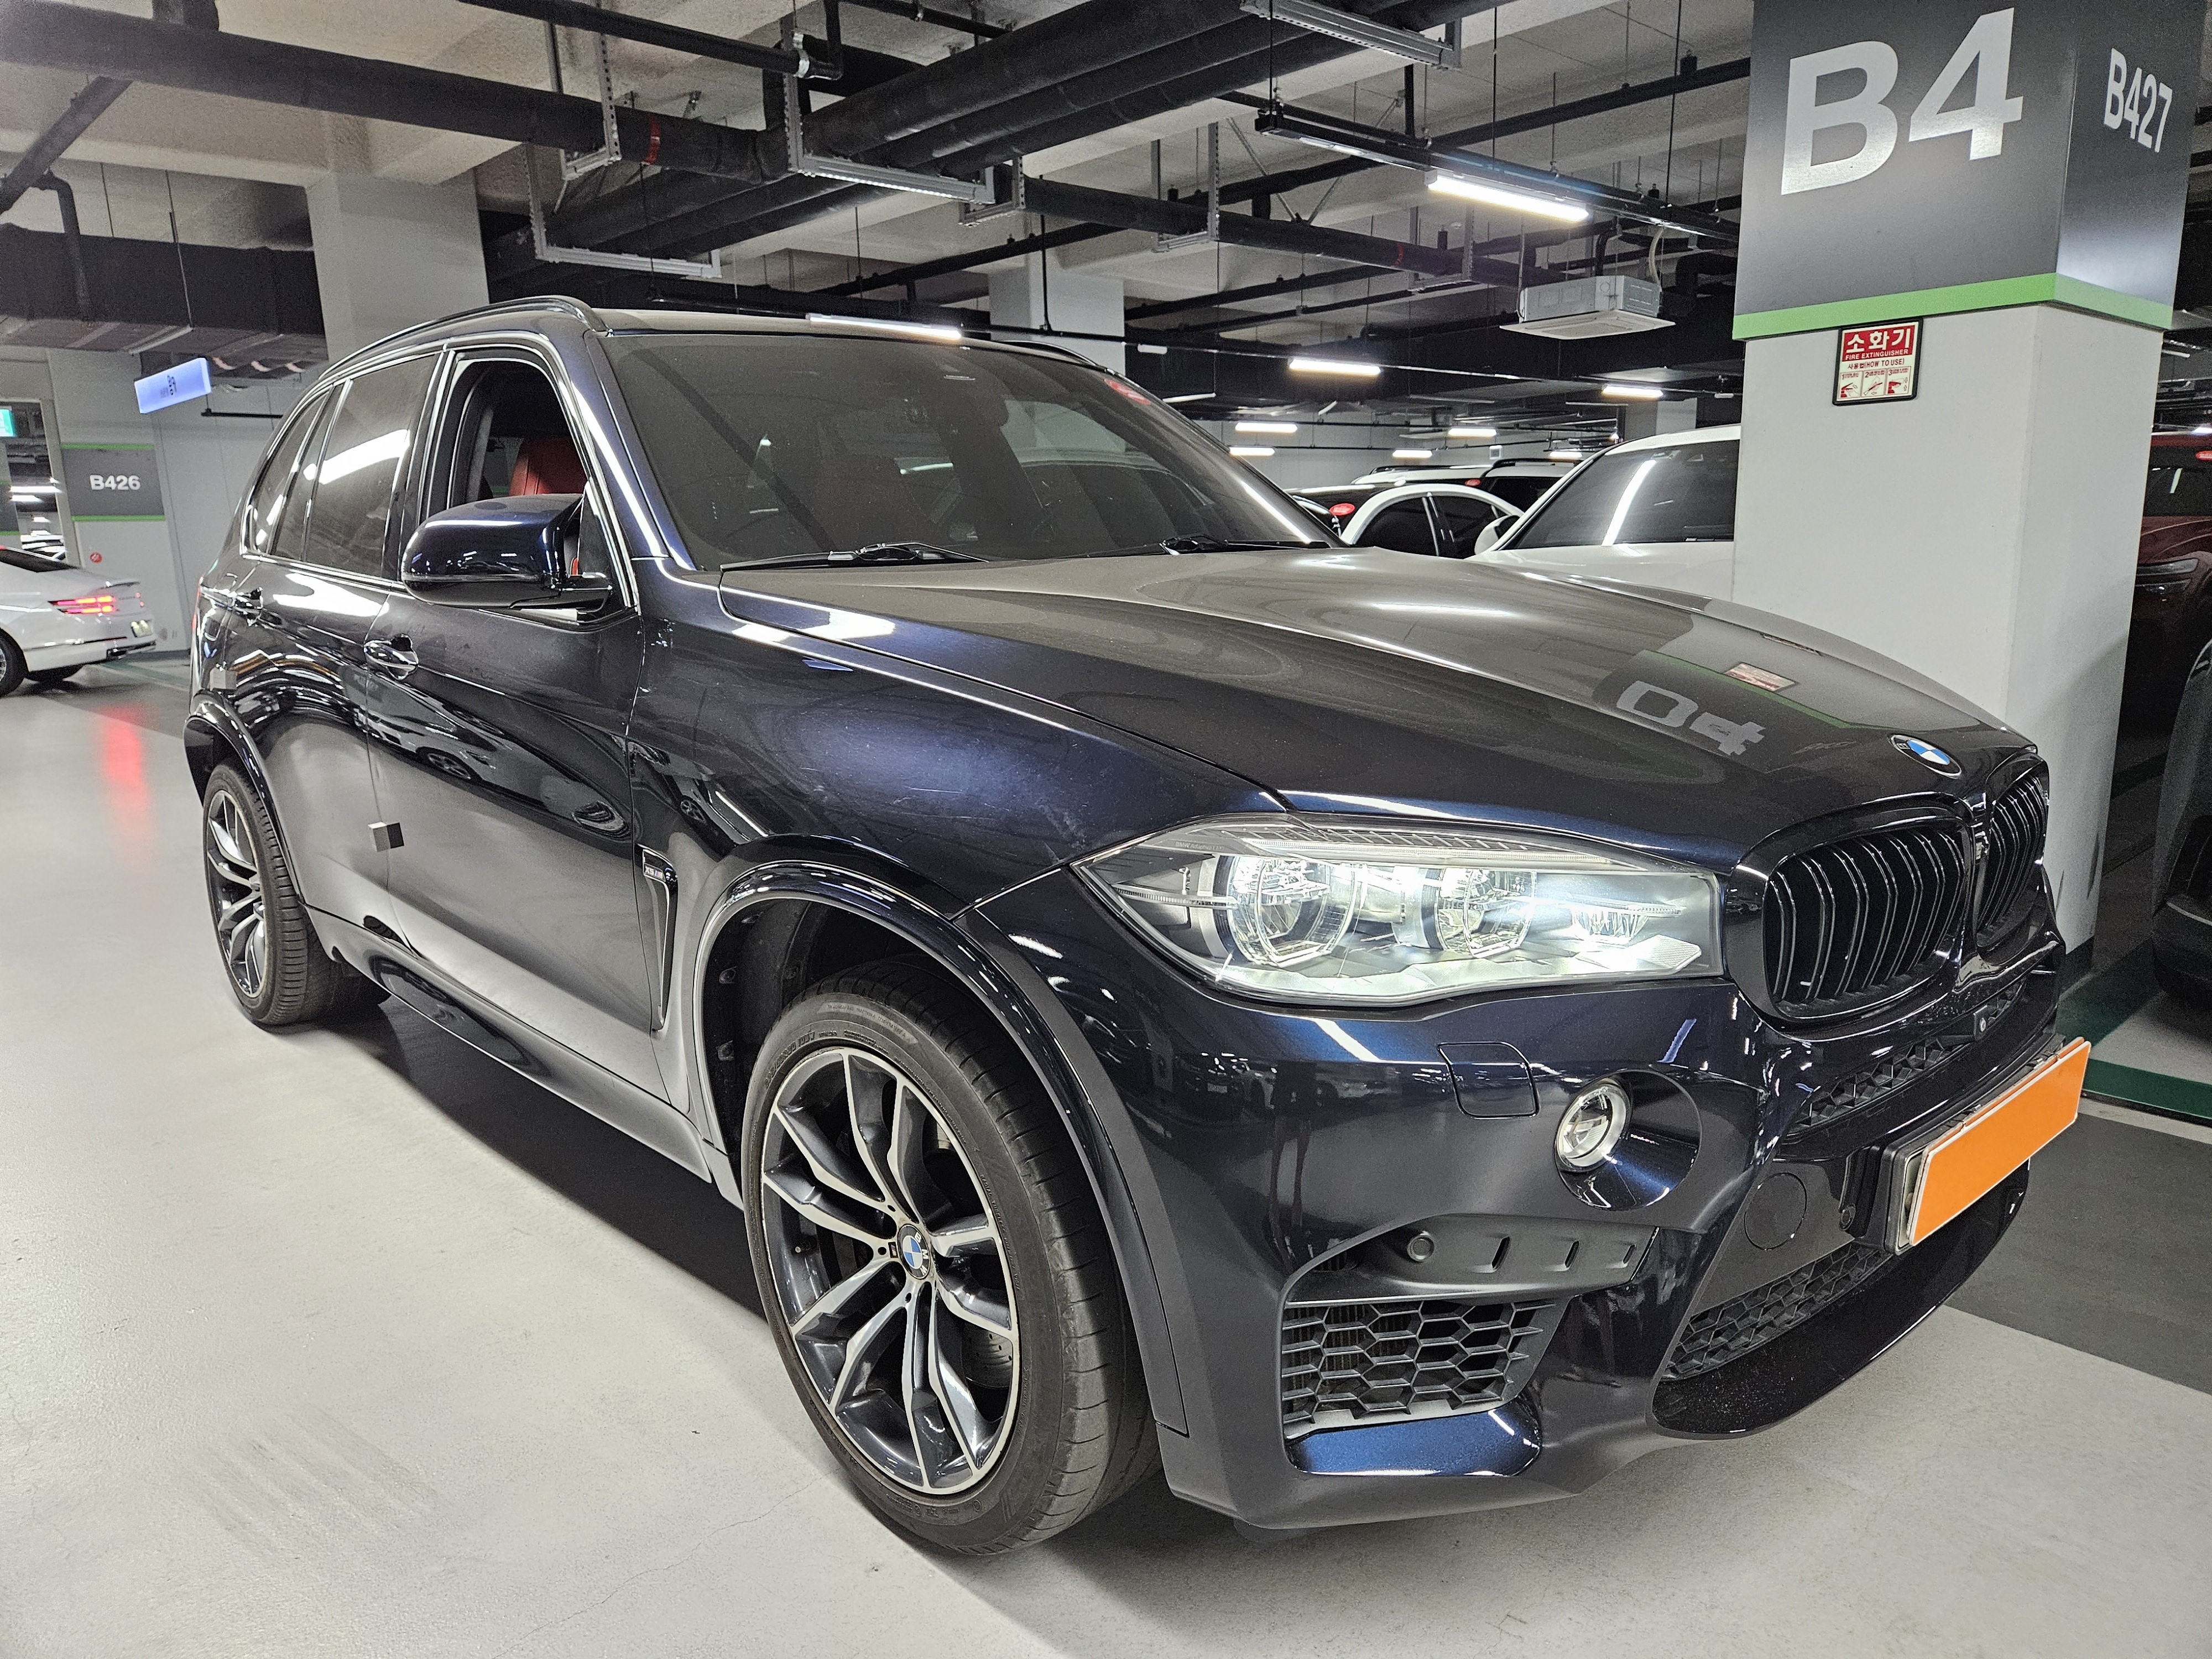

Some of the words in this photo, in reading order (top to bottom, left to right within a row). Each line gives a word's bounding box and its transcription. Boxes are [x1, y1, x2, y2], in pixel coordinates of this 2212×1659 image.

[1781, 7, 2023, 195] B4
[2104, 48, 2173, 153] B427
[1846, 328, 1911, 353] 소화기
[1861, 349, 1908, 359] EXTINGUISHER
[90, 475, 140, 491] B426
[914, 1232, 929, 1276] BMW
